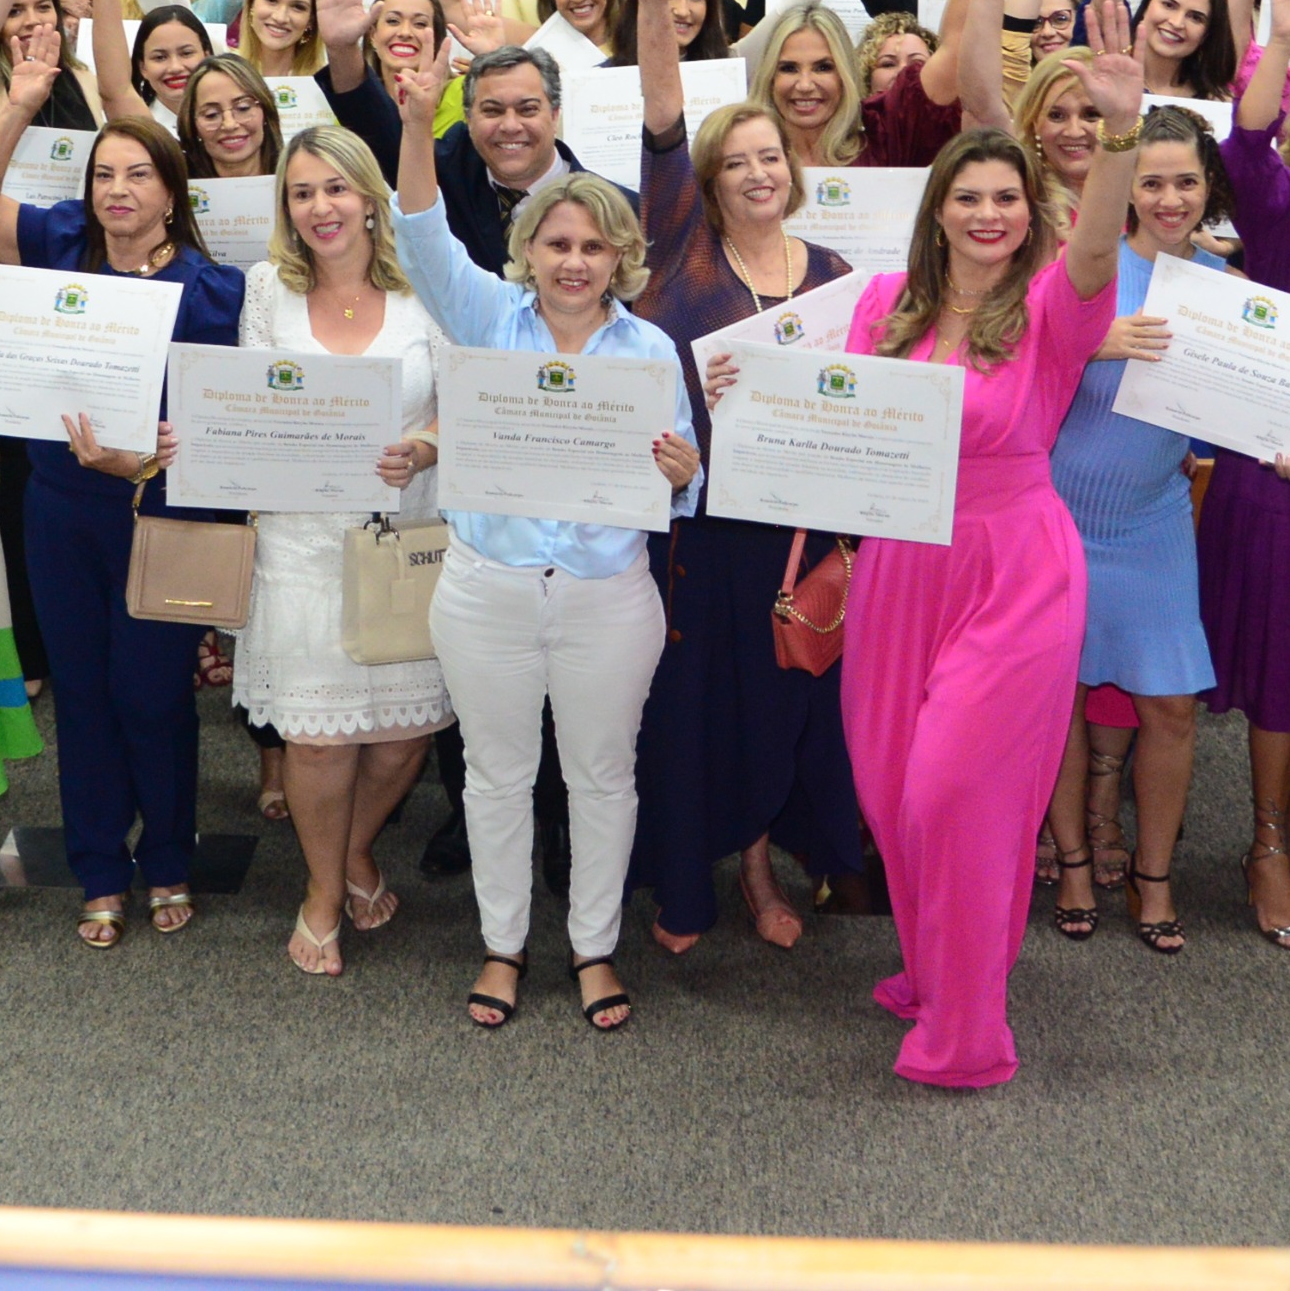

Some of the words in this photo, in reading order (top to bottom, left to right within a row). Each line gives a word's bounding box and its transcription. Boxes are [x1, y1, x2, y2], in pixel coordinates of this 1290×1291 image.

[202, 388, 251, 403] Diploma
[255, 392, 268, 403] de
[272, 393, 309, 406] Honra
[312, 396, 325, 406] ao
[329, 395, 370, 408] Mérito
[478, 392, 524, 405] Diploma
[528, 396, 539, 406] de
[543, 397, 578, 409] Honra
[581, 401, 593, 410] ao
[597, 401, 634, 413] Mérito
[750, 390, 800, 410] Diploma
[803, 400, 817, 410] de
[821, 400, 860, 415] Honra
[863, 407, 877, 417] ao
[882, 407, 924, 422] Mérito
[494, 407, 526, 417] Câmara
[530, 409, 570, 420] Municipal
[573, 411, 582, 420] de
[584, 412, 616, 423] Goiânia
[205, 426, 242, 437] Fabiana
[245, 429, 267, 438] Pires
[270, 430, 319, 440] Guimarães
[334, 432, 366, 441] Morais
[493, 431, 521, 442] Vanda
[524, 434, 570, 445] Francisco
[573, 438, 615, 449] Camargo
[757, 433, 785, 446] Bruna
[788, 437, 818, 450] Karlla
[821, 442, 862, 455] Dourado
[865, 446, 909, 460] Tomazetti
[409, 548, 446, 566] SCHUT
